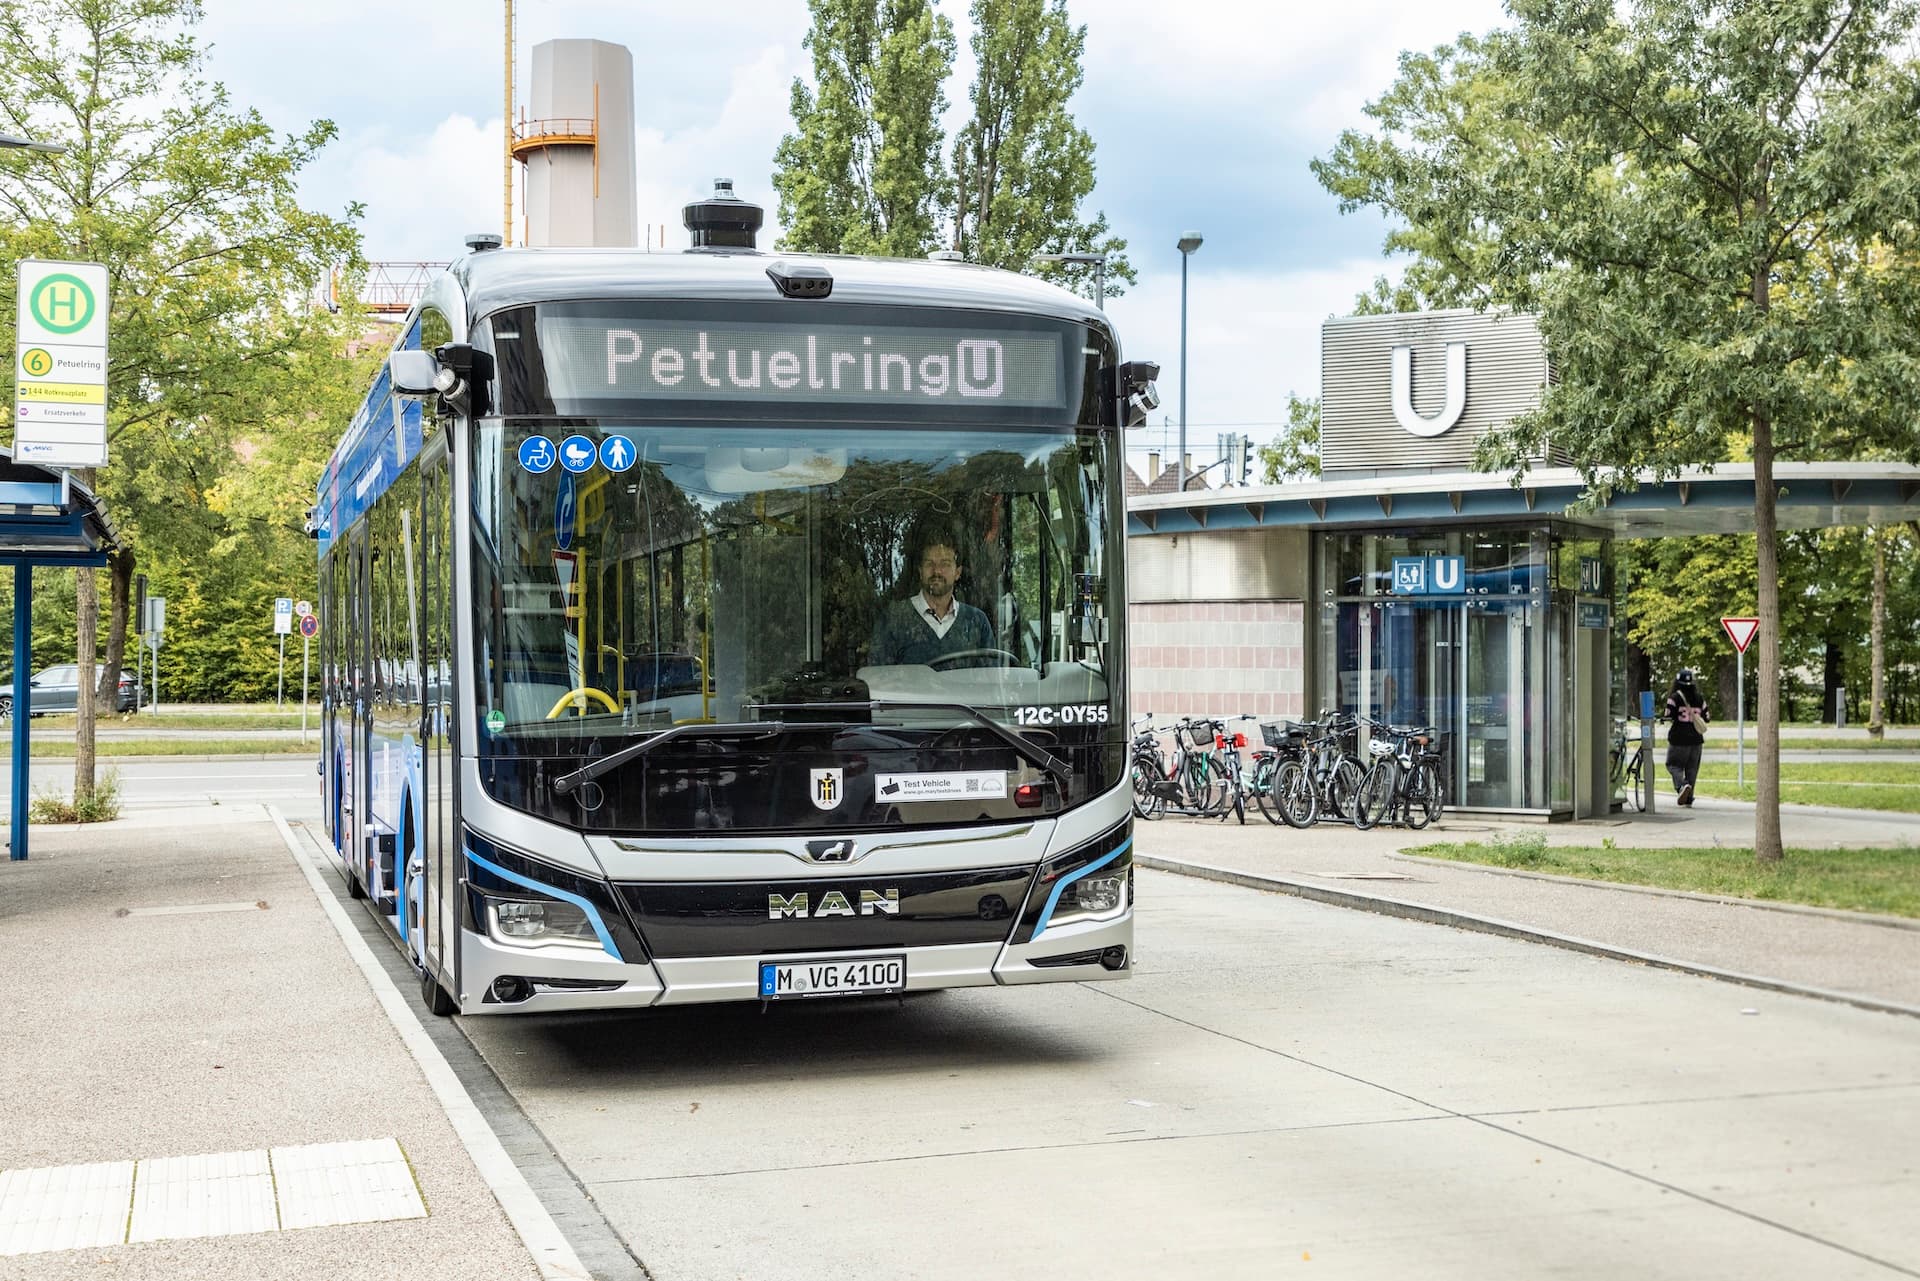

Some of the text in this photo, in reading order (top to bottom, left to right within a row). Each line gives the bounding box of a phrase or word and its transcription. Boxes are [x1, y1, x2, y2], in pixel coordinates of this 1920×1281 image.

[49, 286, 77, 322] H
[30, 353, 101, 371] 6 Petuelring
[607, 329, 950, 396] Petuelring
[28, 387, 42, 395] 144
[44, 389, 87, 397] Rotkreuzplatz
[1391, 341, 1467, 437] U
[44, 408, 86, 416] Ersatzverkehr
[1435, 559, 1458, 590] U
[1592, 561, 1601, 590] U
[278, 600, 288, 612] P
[903, 779, 951, 788] Test Vehicle
[768, 888, 900, 920] MAN
[765, 962, 900, 990] D M VG 4100
